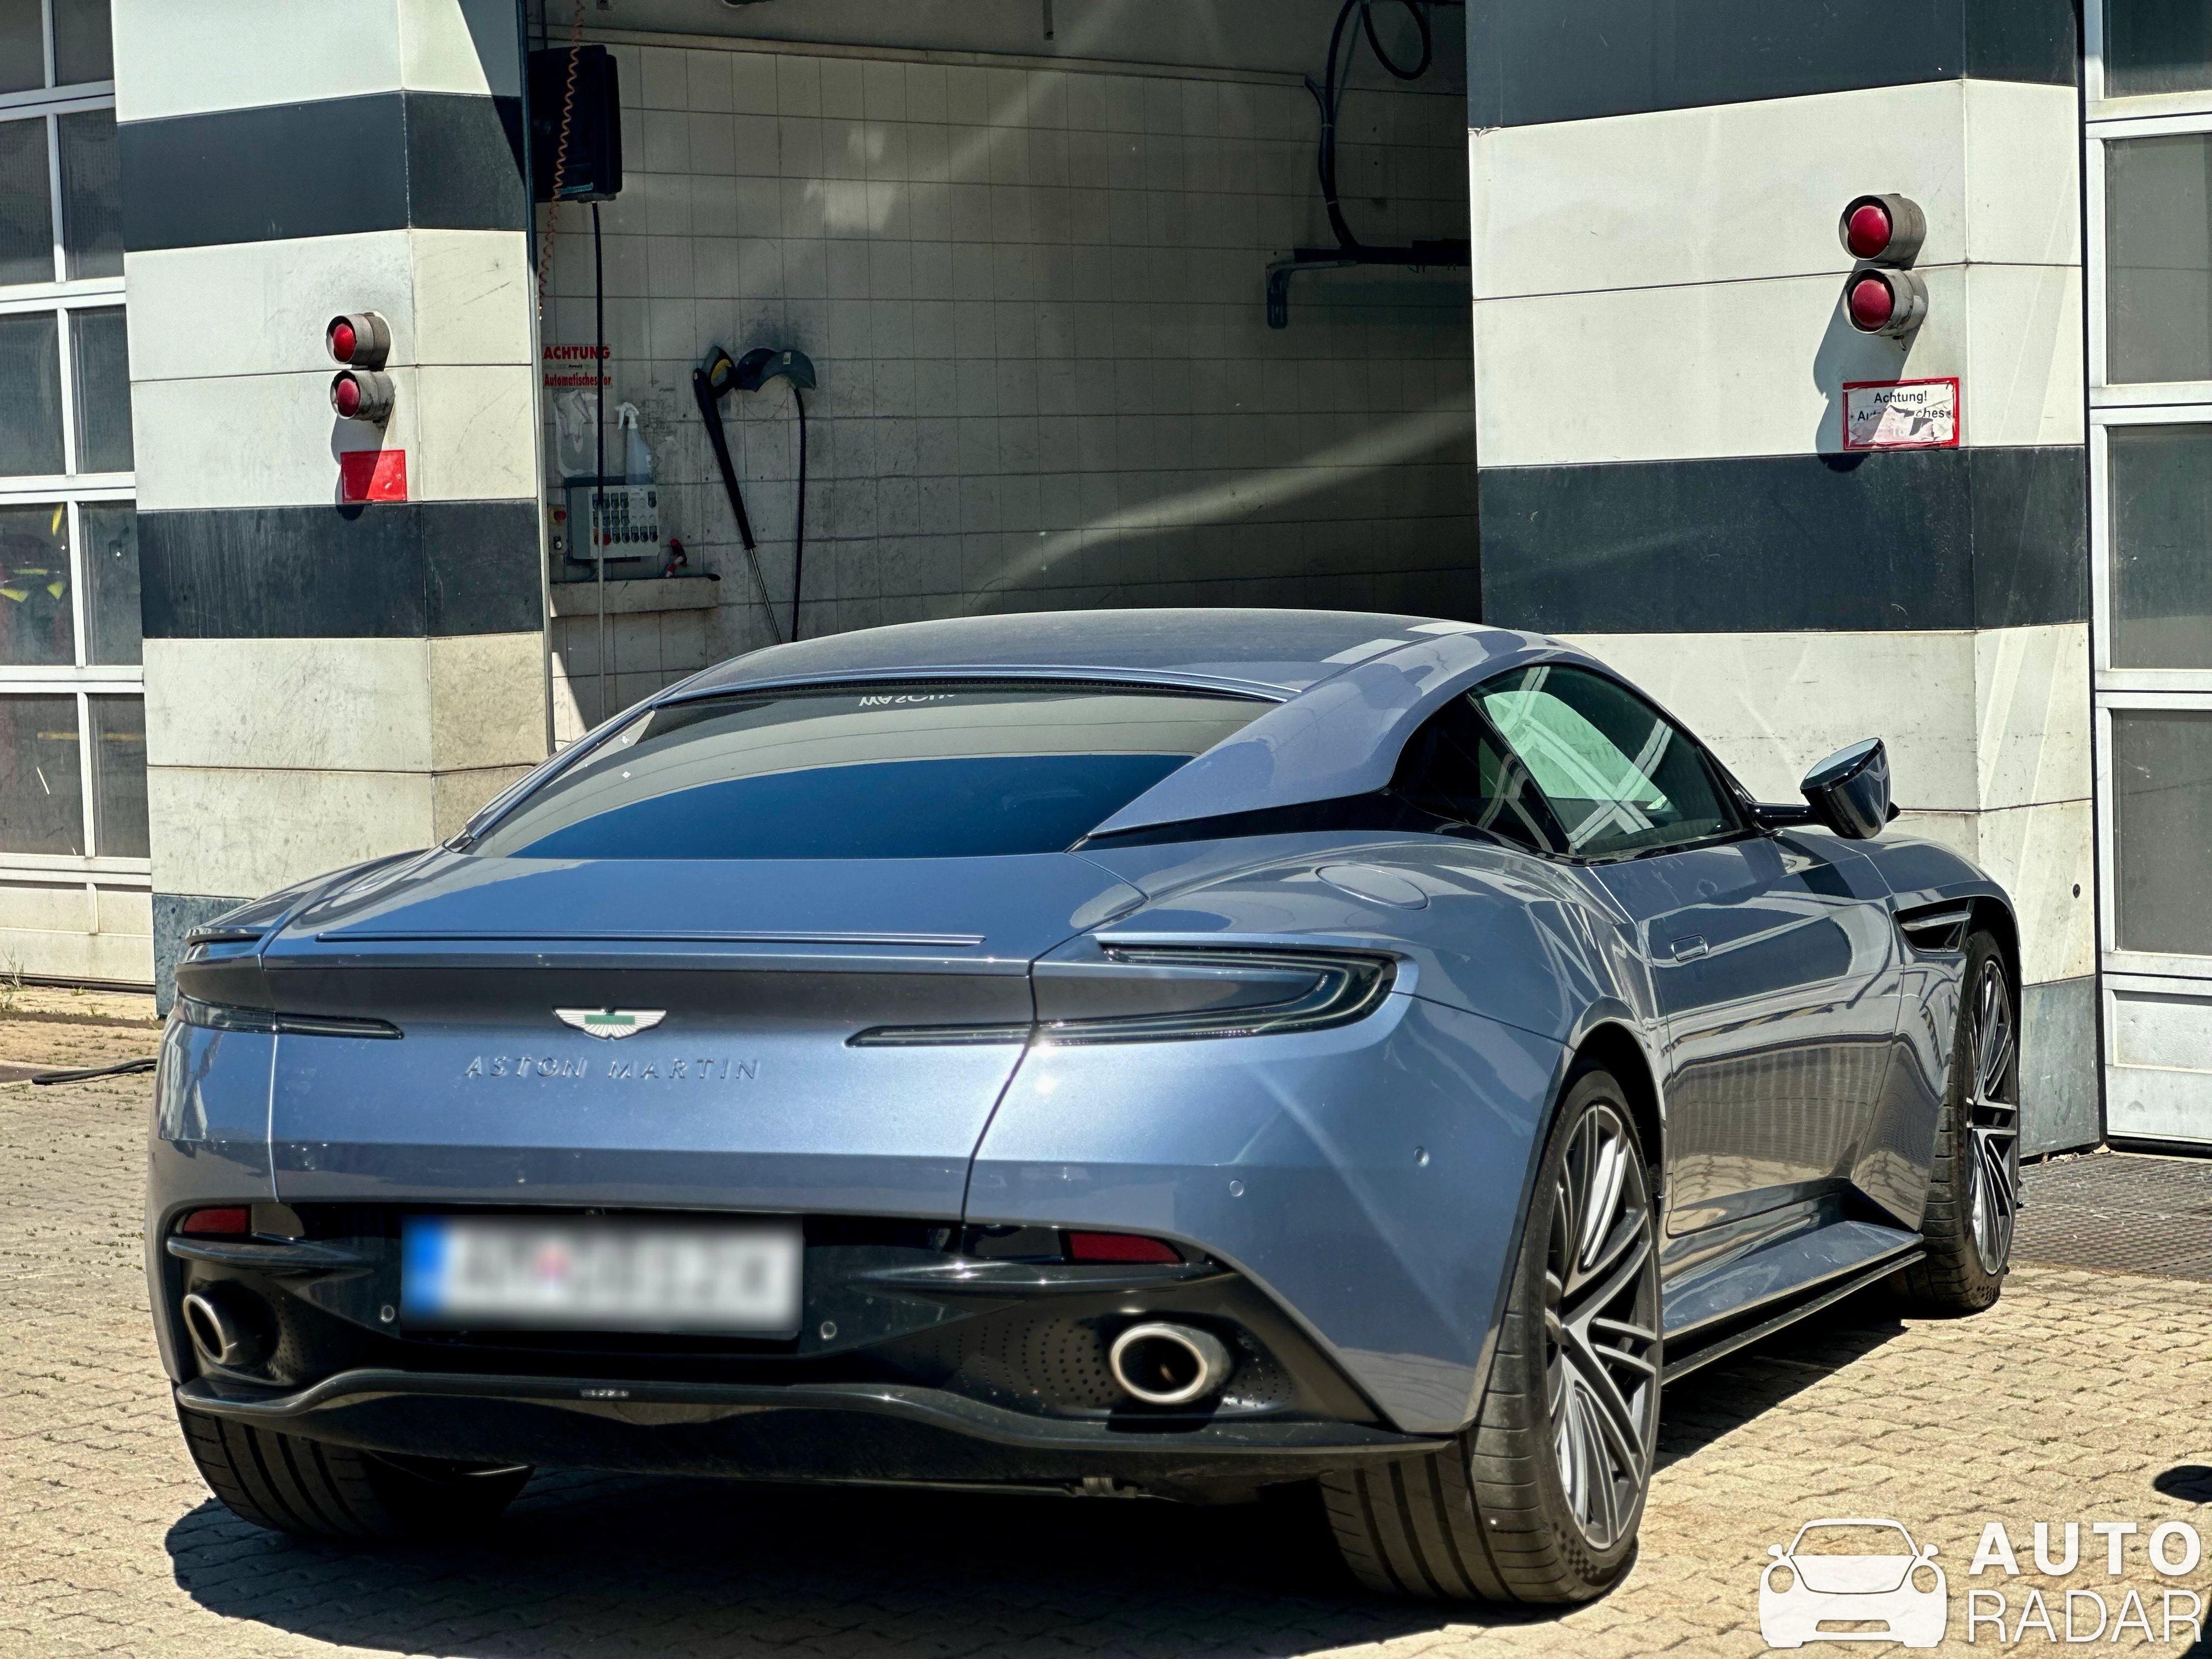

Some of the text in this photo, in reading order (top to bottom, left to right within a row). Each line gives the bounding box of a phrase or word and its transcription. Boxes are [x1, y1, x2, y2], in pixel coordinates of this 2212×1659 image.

[544, 346, 610, 359] ACHTUNG
[545, 372, 597, 386] Automatisches
[1874, 390, 1927, 404] Achtung!
[464, 1056, 758, 1080] ASTON MARTIN
